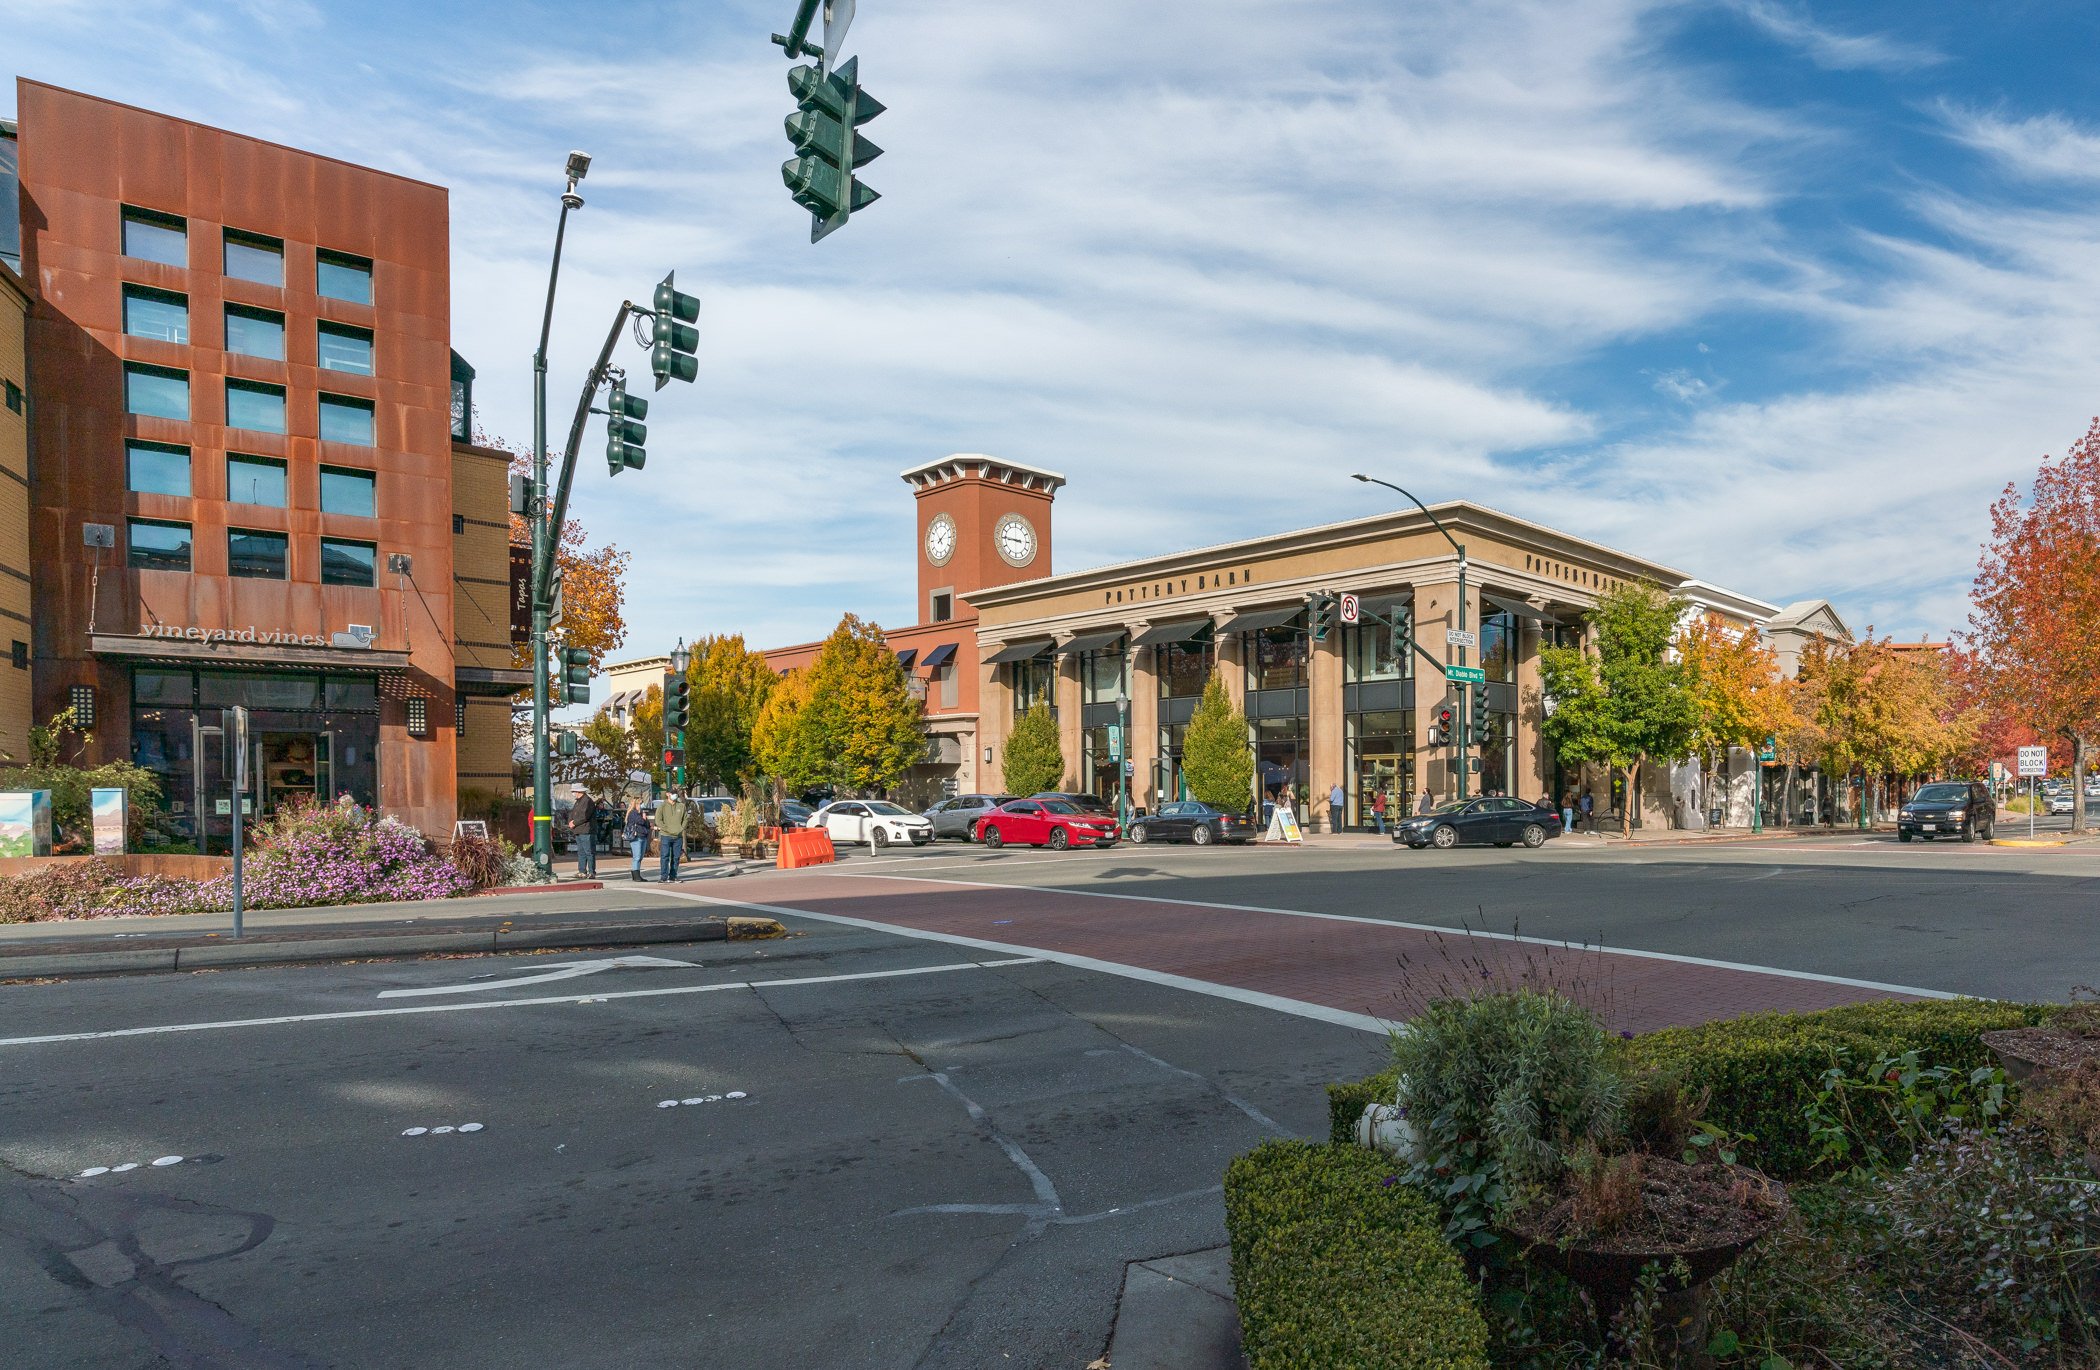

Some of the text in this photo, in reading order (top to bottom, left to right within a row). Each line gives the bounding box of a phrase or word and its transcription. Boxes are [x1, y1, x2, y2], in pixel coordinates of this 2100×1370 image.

[1526, 554, 1587, 585] POTTERY
[516, 578, 529, 611] Tapas
[1105, 569, 1250, 605] POTTERY BARN
[141, 620, 326, 647] vineyard vines
[1456, 670, 1468, 678] Diablo
